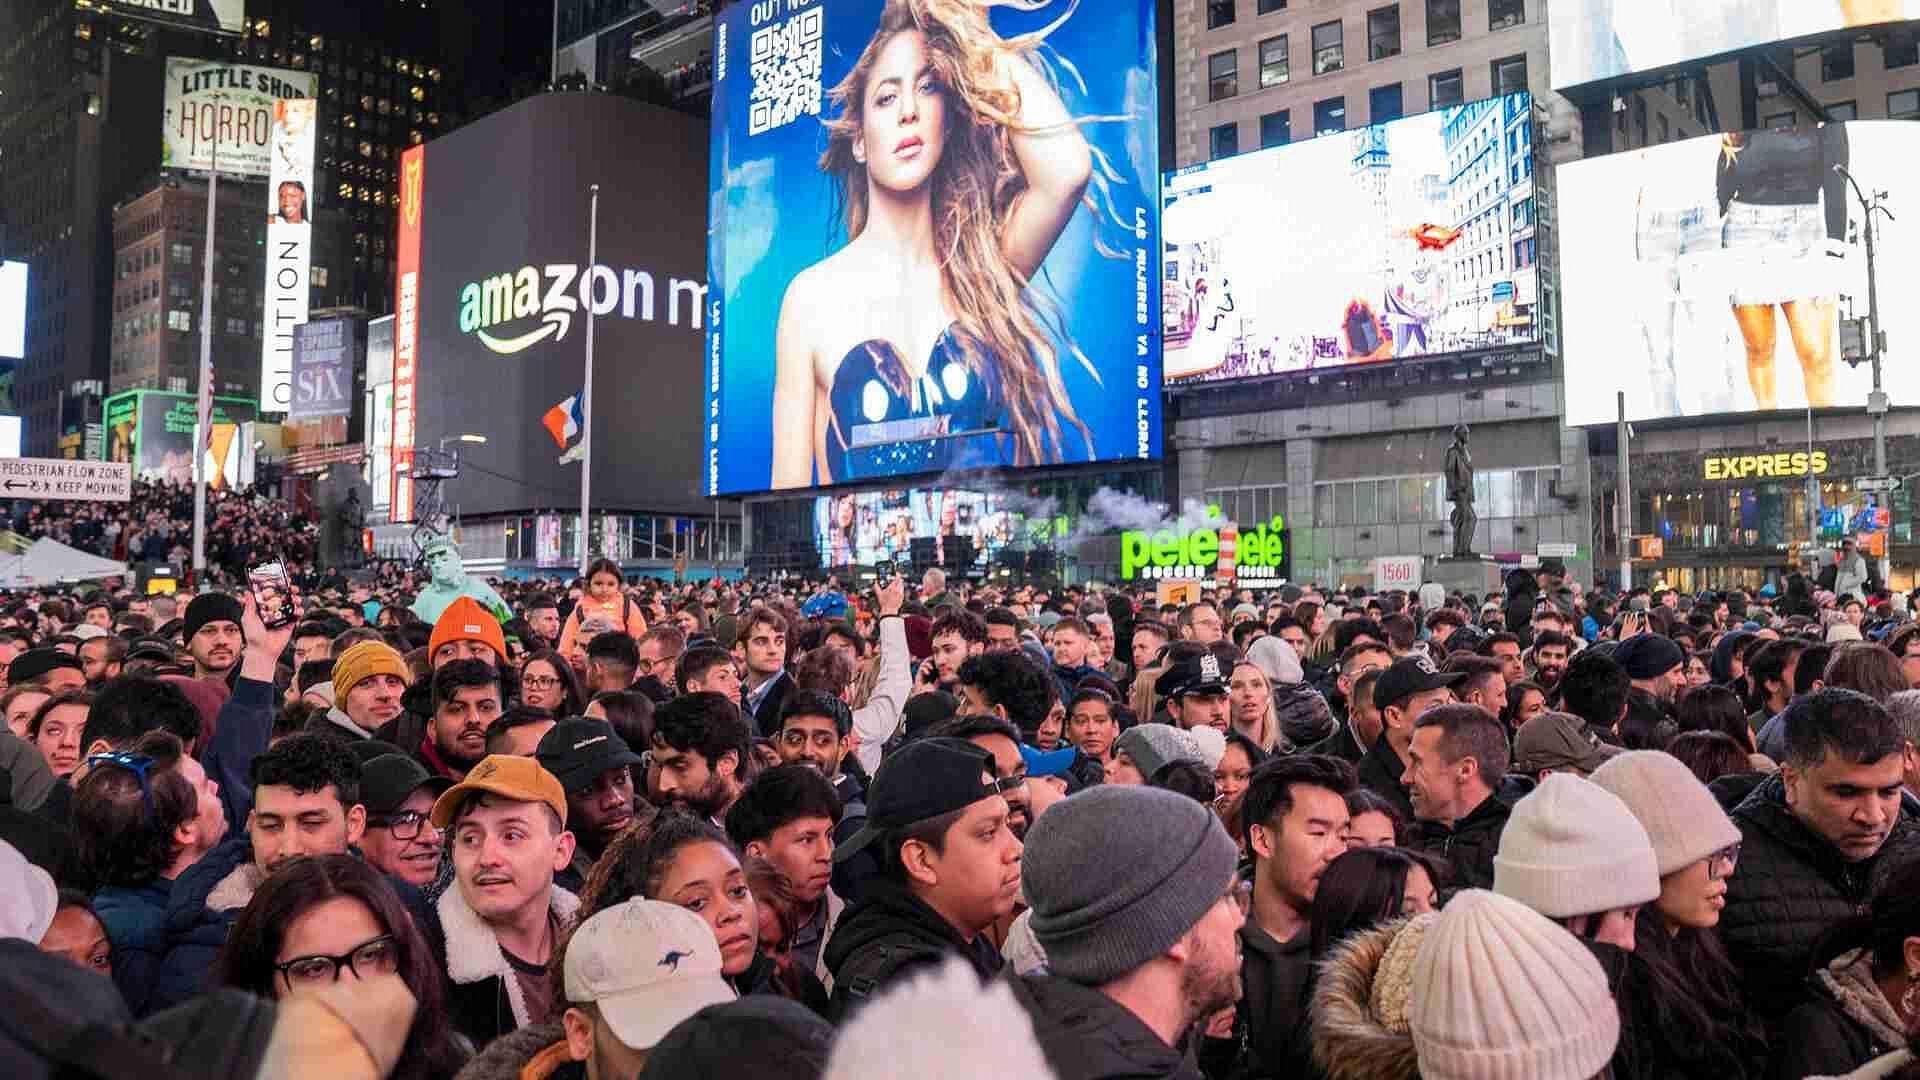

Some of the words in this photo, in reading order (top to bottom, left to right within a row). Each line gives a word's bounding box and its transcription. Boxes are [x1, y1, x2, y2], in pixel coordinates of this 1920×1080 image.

[182, 68, 252, 95] LITTLE
[1135, 207, 1147, 240] LAS
[459, 263, 655, 334] amazon
[1136, 247, 1148, 325] MUJERES
[1137, 334, 1148, 356] YA
[1137, 365, 1149, 389] NO
[3, 462, 64, 477] PEDESTRIAN
[66, 465, 95, 479] FLOW
[98, 467, 125, 480] ZONE
[1704, 451, 1828, 480] EXPRESS
[55, 481, 82, 494] KEEP
[86, 482, 125, 496] MOVING
